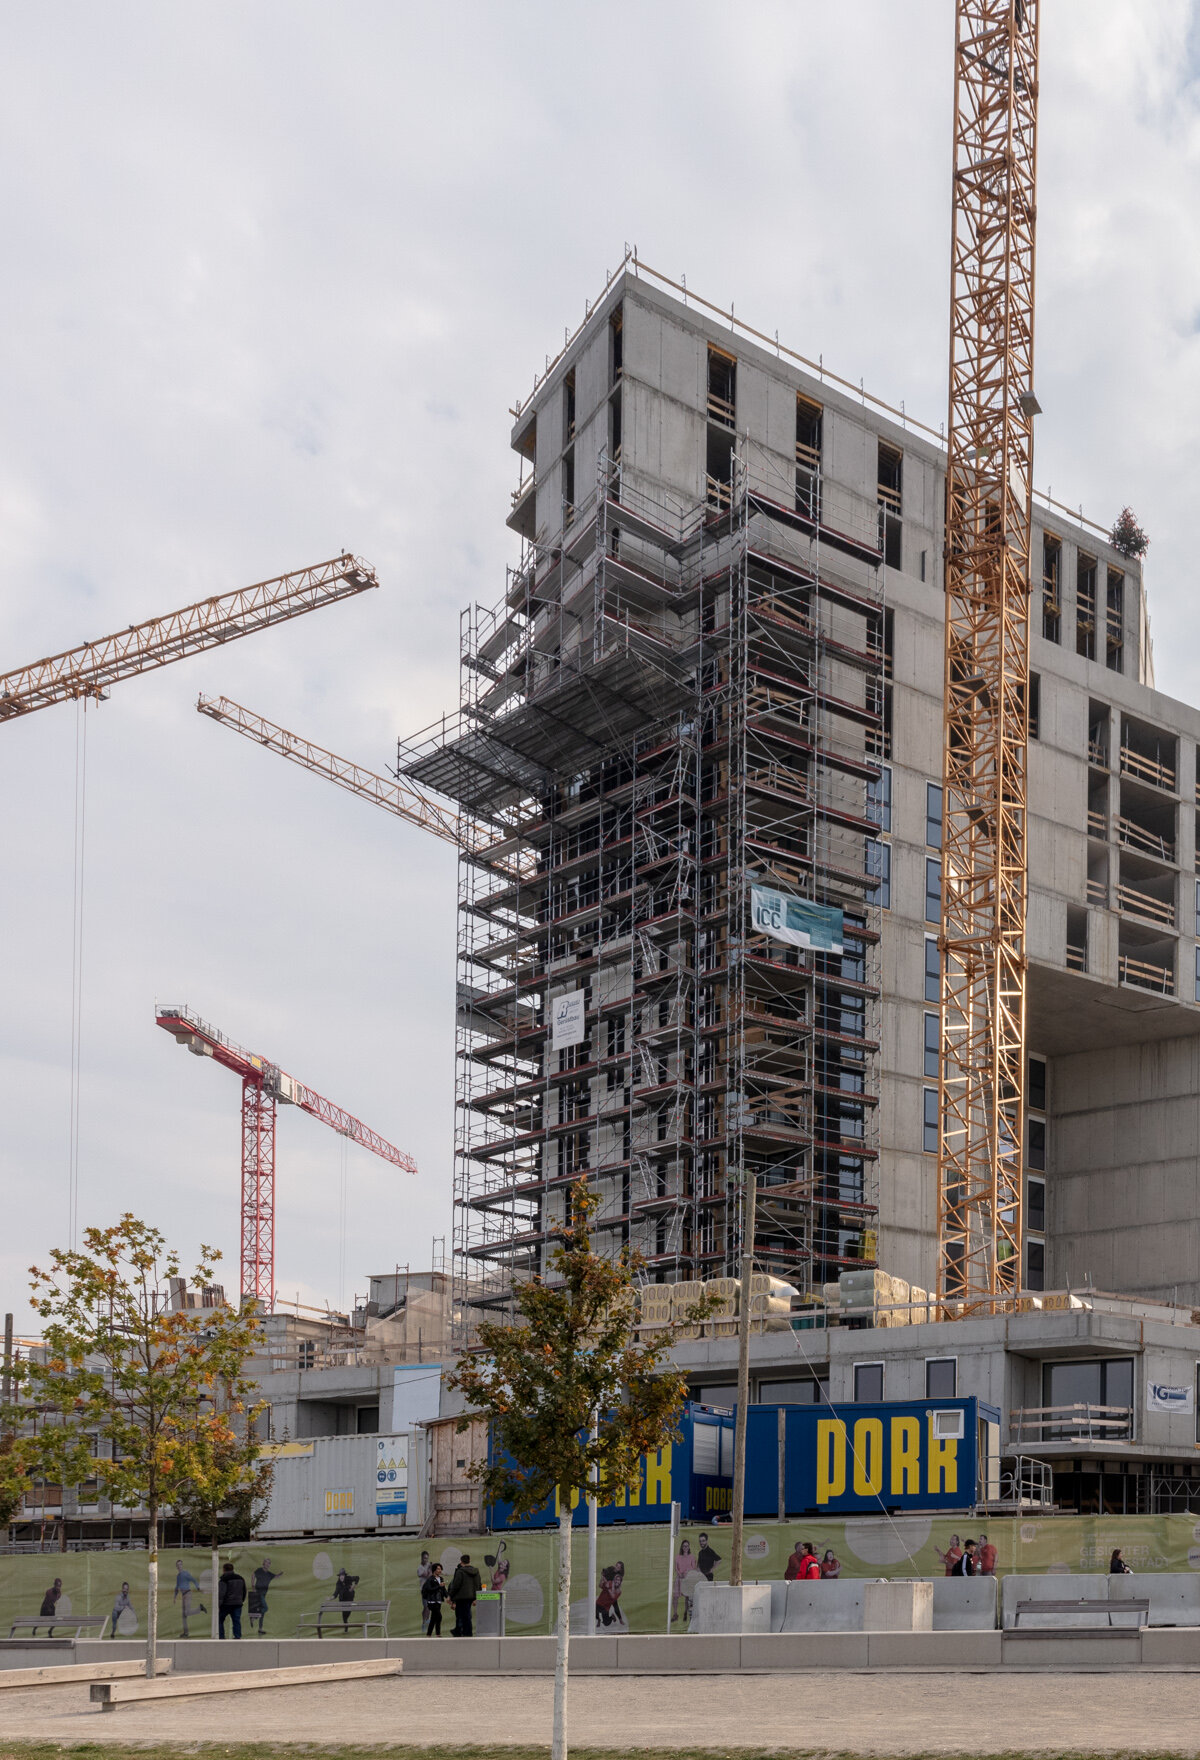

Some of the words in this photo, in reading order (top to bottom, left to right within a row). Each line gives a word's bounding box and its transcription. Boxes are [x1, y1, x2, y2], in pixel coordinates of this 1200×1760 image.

[756, 906, 781, 930] ICC
[816, 1416, 958, 1504] PORR
[326, 1491, 353, 1513] PORR
